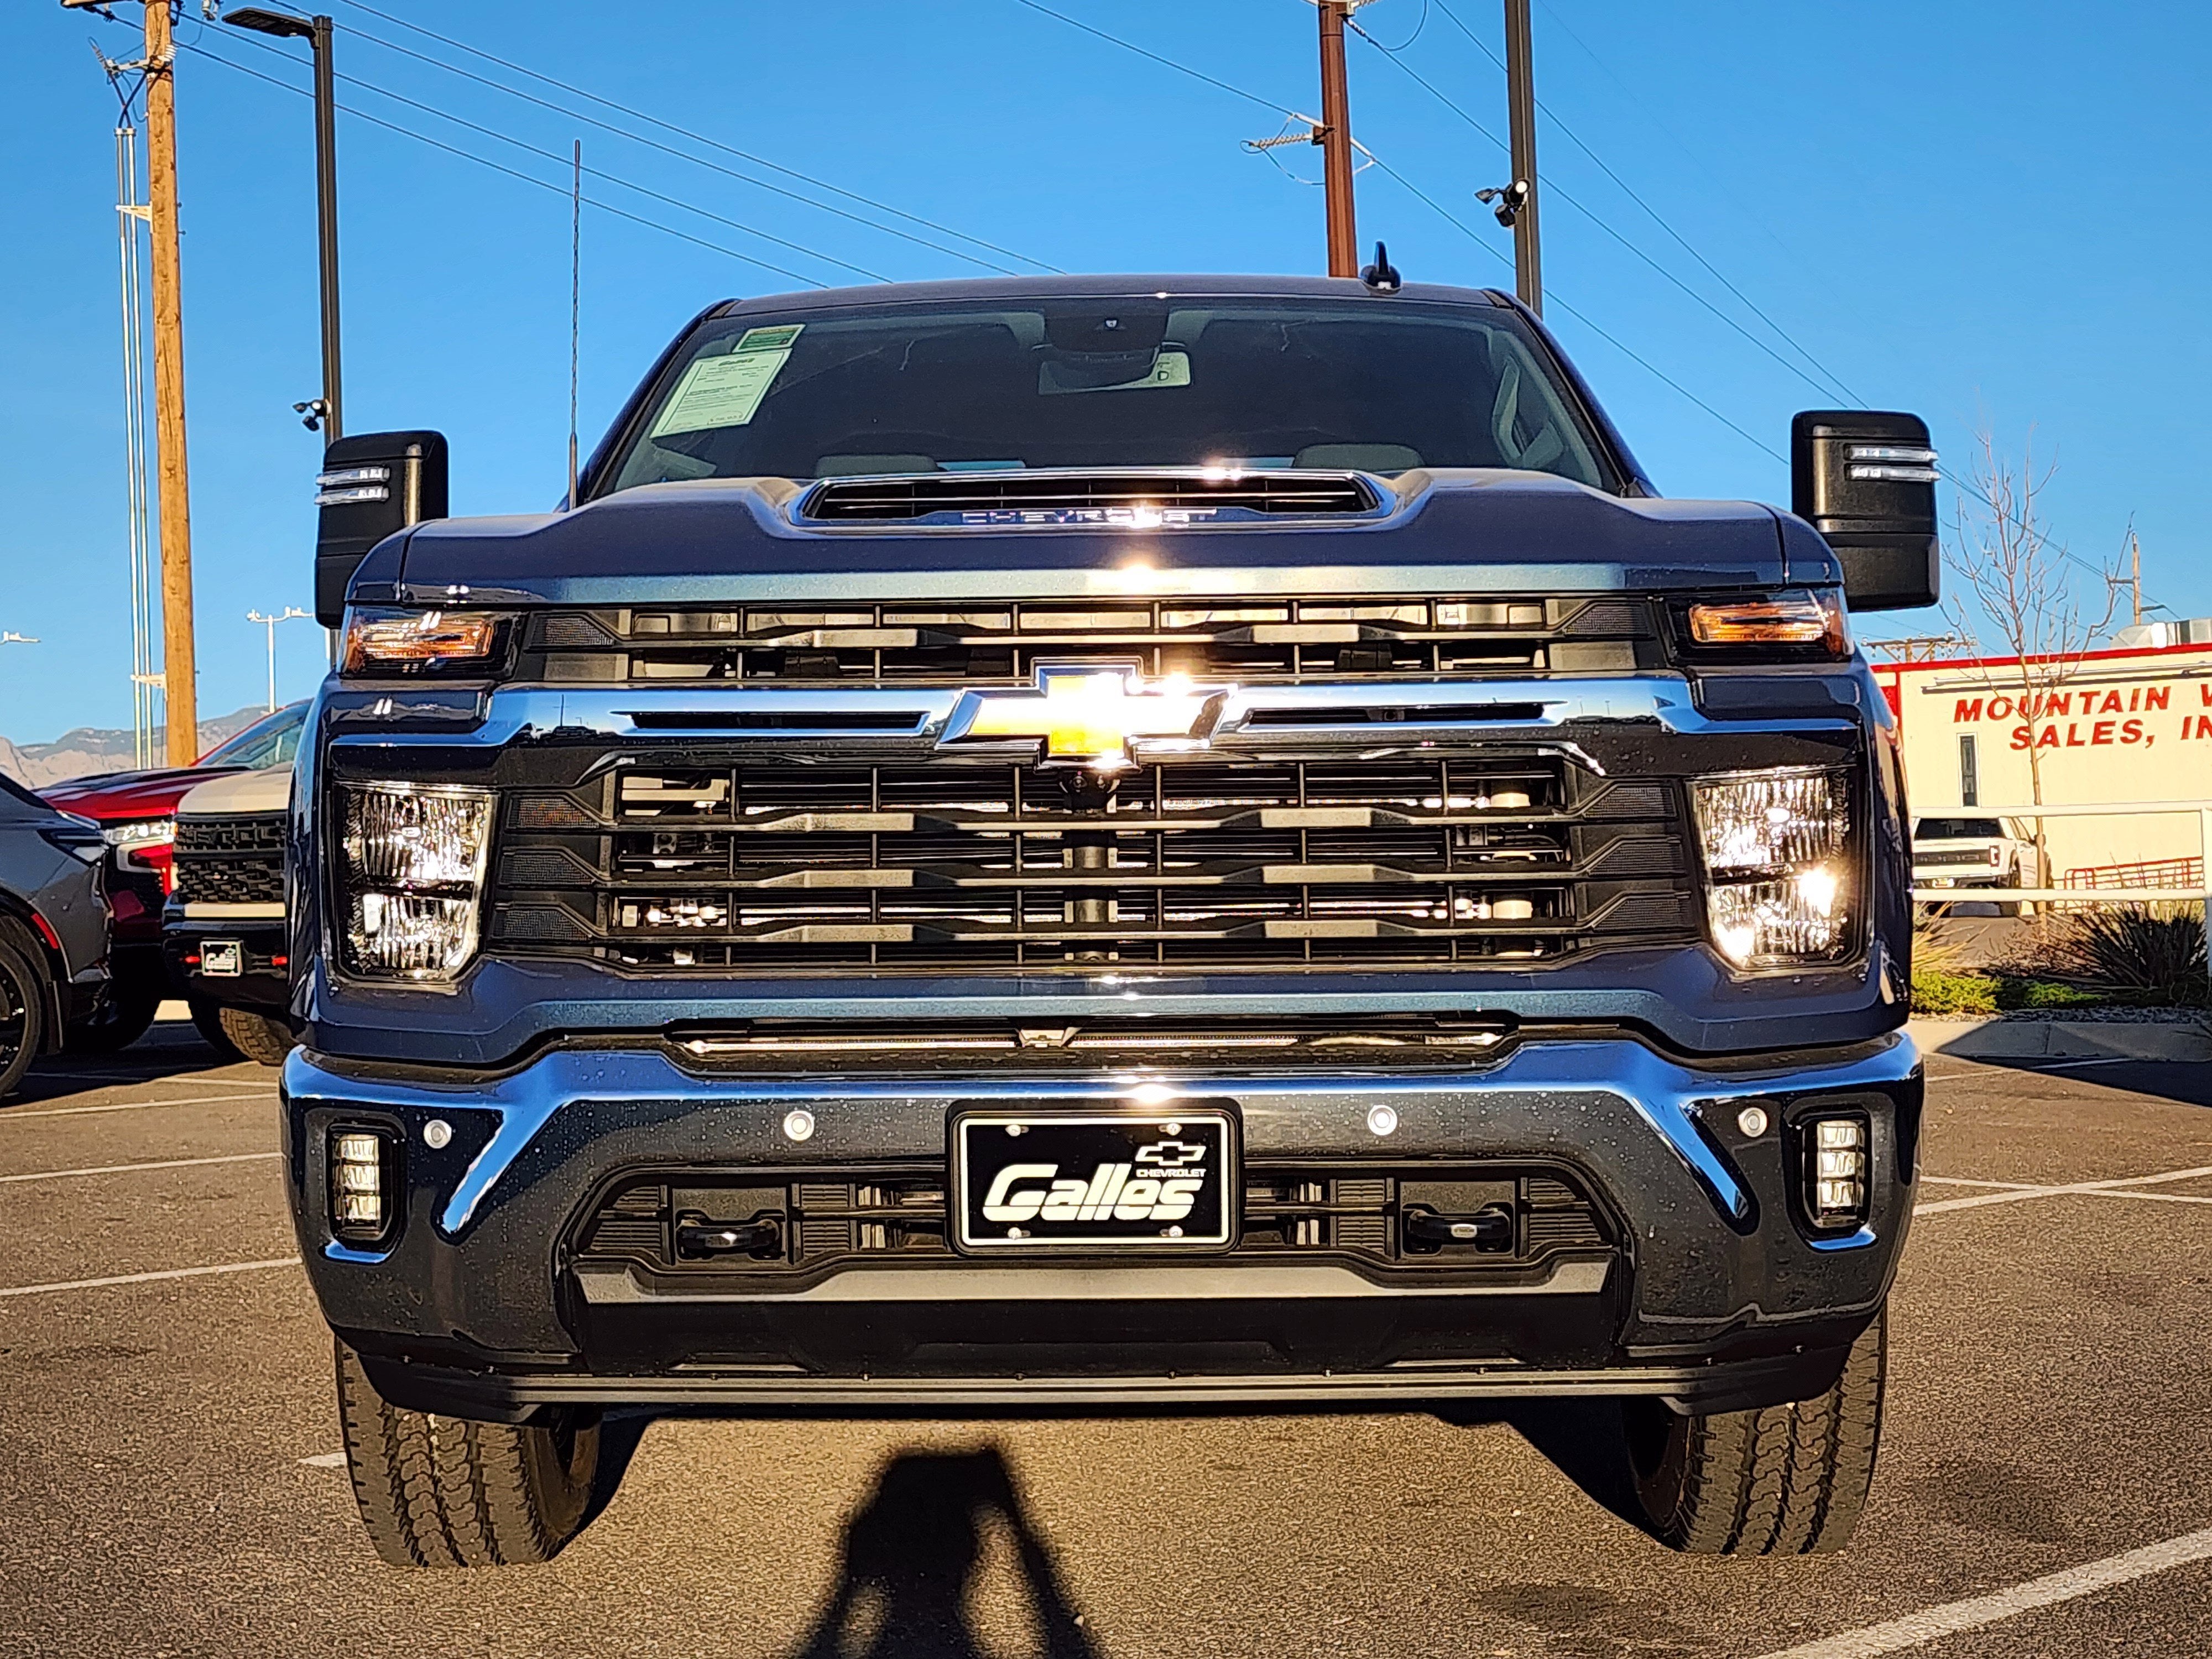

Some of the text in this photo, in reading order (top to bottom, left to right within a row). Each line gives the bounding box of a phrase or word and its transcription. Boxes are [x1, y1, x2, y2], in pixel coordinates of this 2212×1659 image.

[1954, 686, 2171, 723] MOUNTAIN
[2010, 719, 2155, 750] SALES,
[1136, 1168, 1206, 1177] CHEVROLET
[983, 1164, 1203, 1221] Galles
